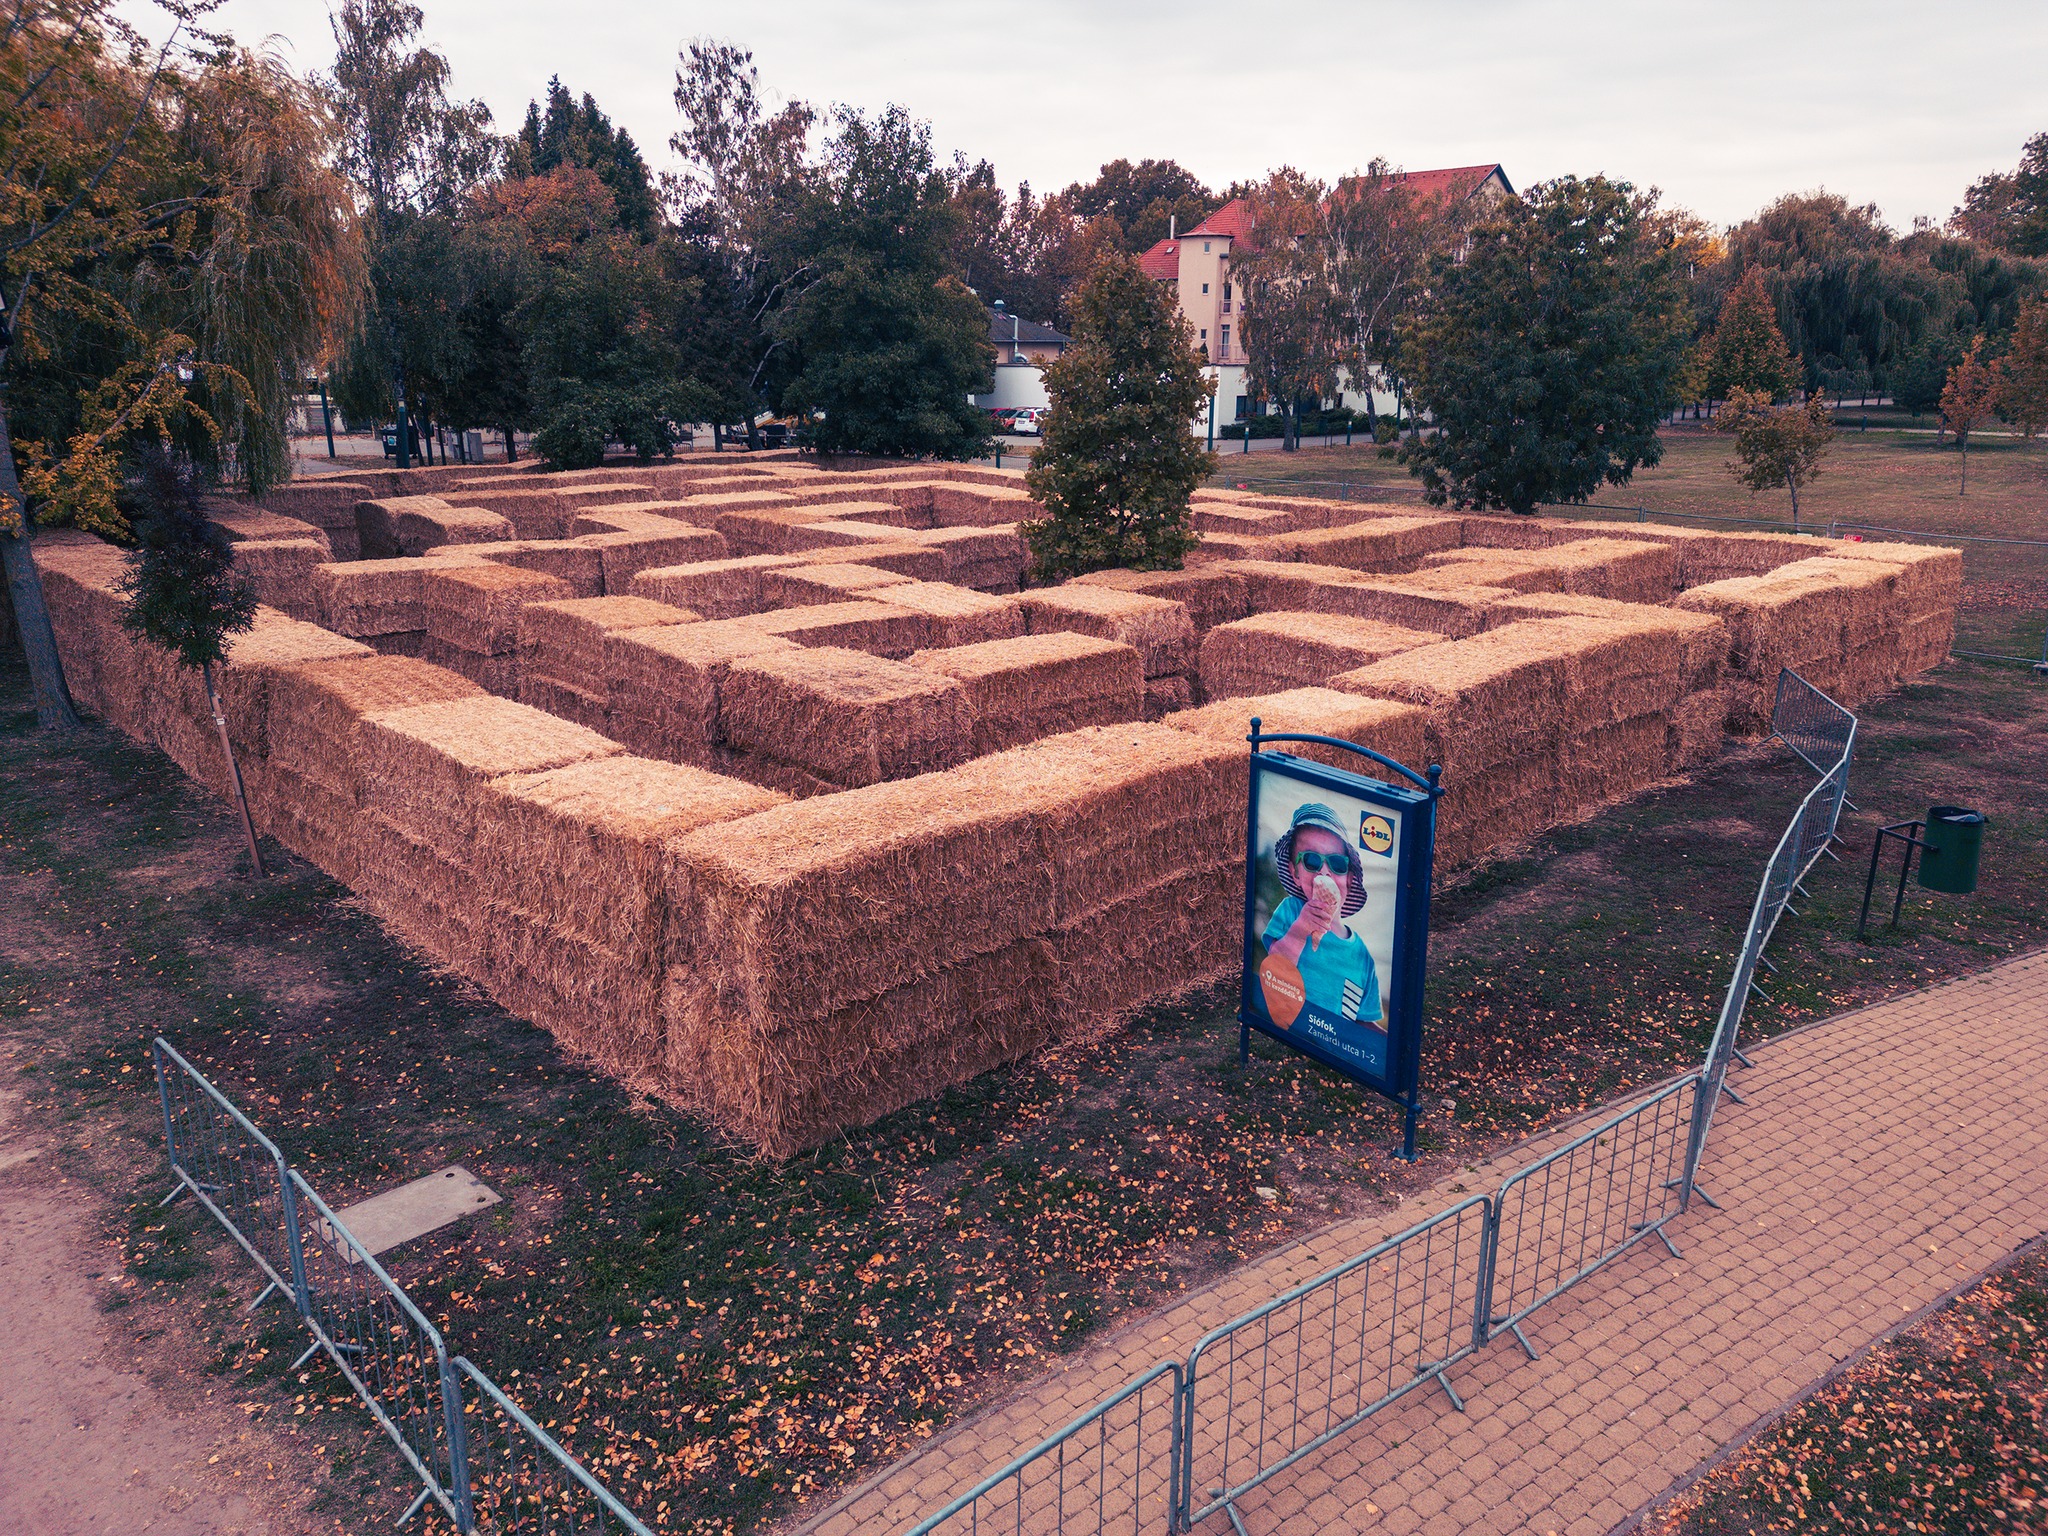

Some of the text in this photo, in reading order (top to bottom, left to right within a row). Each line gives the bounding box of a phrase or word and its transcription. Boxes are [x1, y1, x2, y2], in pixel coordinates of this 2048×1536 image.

[1308, 1014, 1337, 1036] Siófok,
[1308, 1025, 1340, 1047] Zamárdi
[1342, 1042, 1360, 1057] utca
